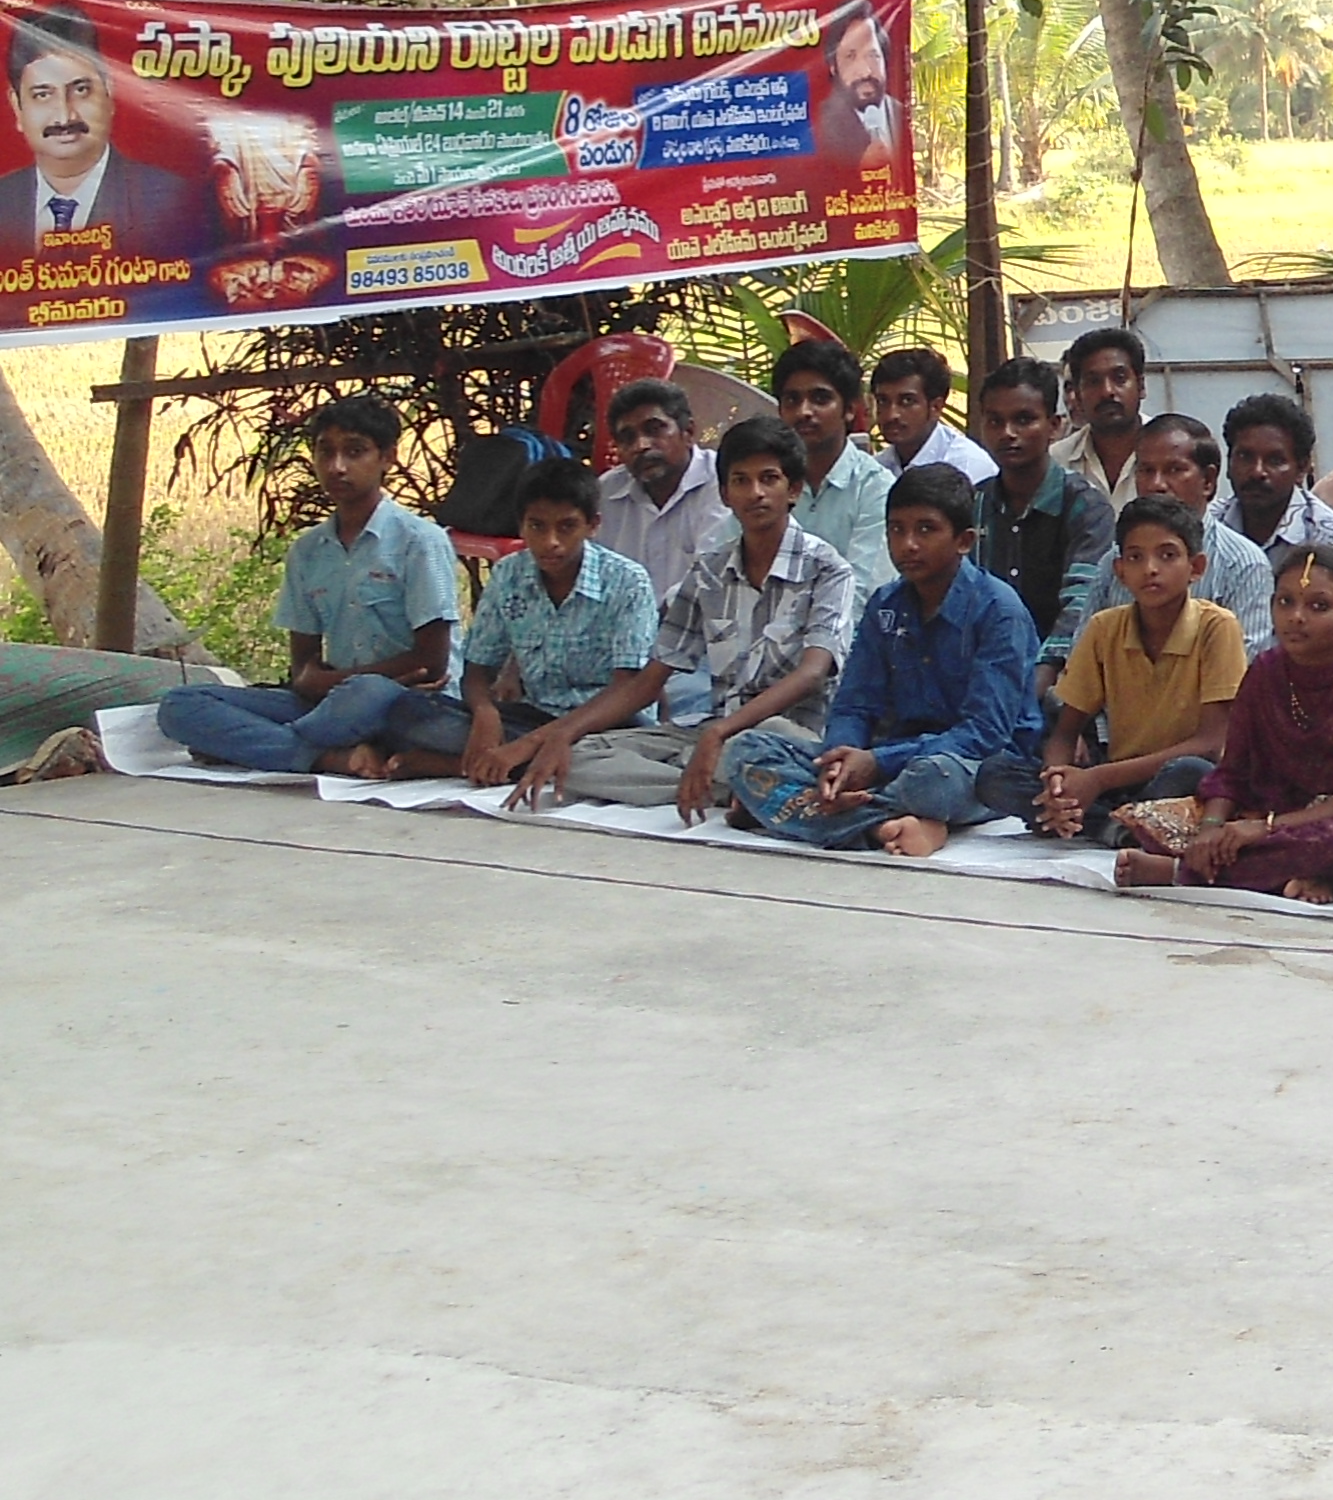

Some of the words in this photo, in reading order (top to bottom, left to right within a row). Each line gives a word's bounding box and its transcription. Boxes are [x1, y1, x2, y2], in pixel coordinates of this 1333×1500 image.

[132, 20, 252, 98] పస్కా
[266, 21, 441, 88] పులియని
[443, 18, 561, 93] రొట్టెల
[568, 8, 685, 63] పండుగ
[691, 2, 821, 58] దినములు
[449, 101, 464, 122] 14
[488, 99, 503, 119] 21
[565, 97, 581, 135] 8
[424, 134, 441, 153] 24
[579, 139, 634, 167] పండుగ
[0, 259, 35, 293] ంత్
[37, 254, 103, 291] కుమార్
[159, 259, 191, 282] గారు
[350, 265, 409, 290] 98493
[413, 260, 469, 285] 85038
[28, 296, 125, 326] భీమవరం
